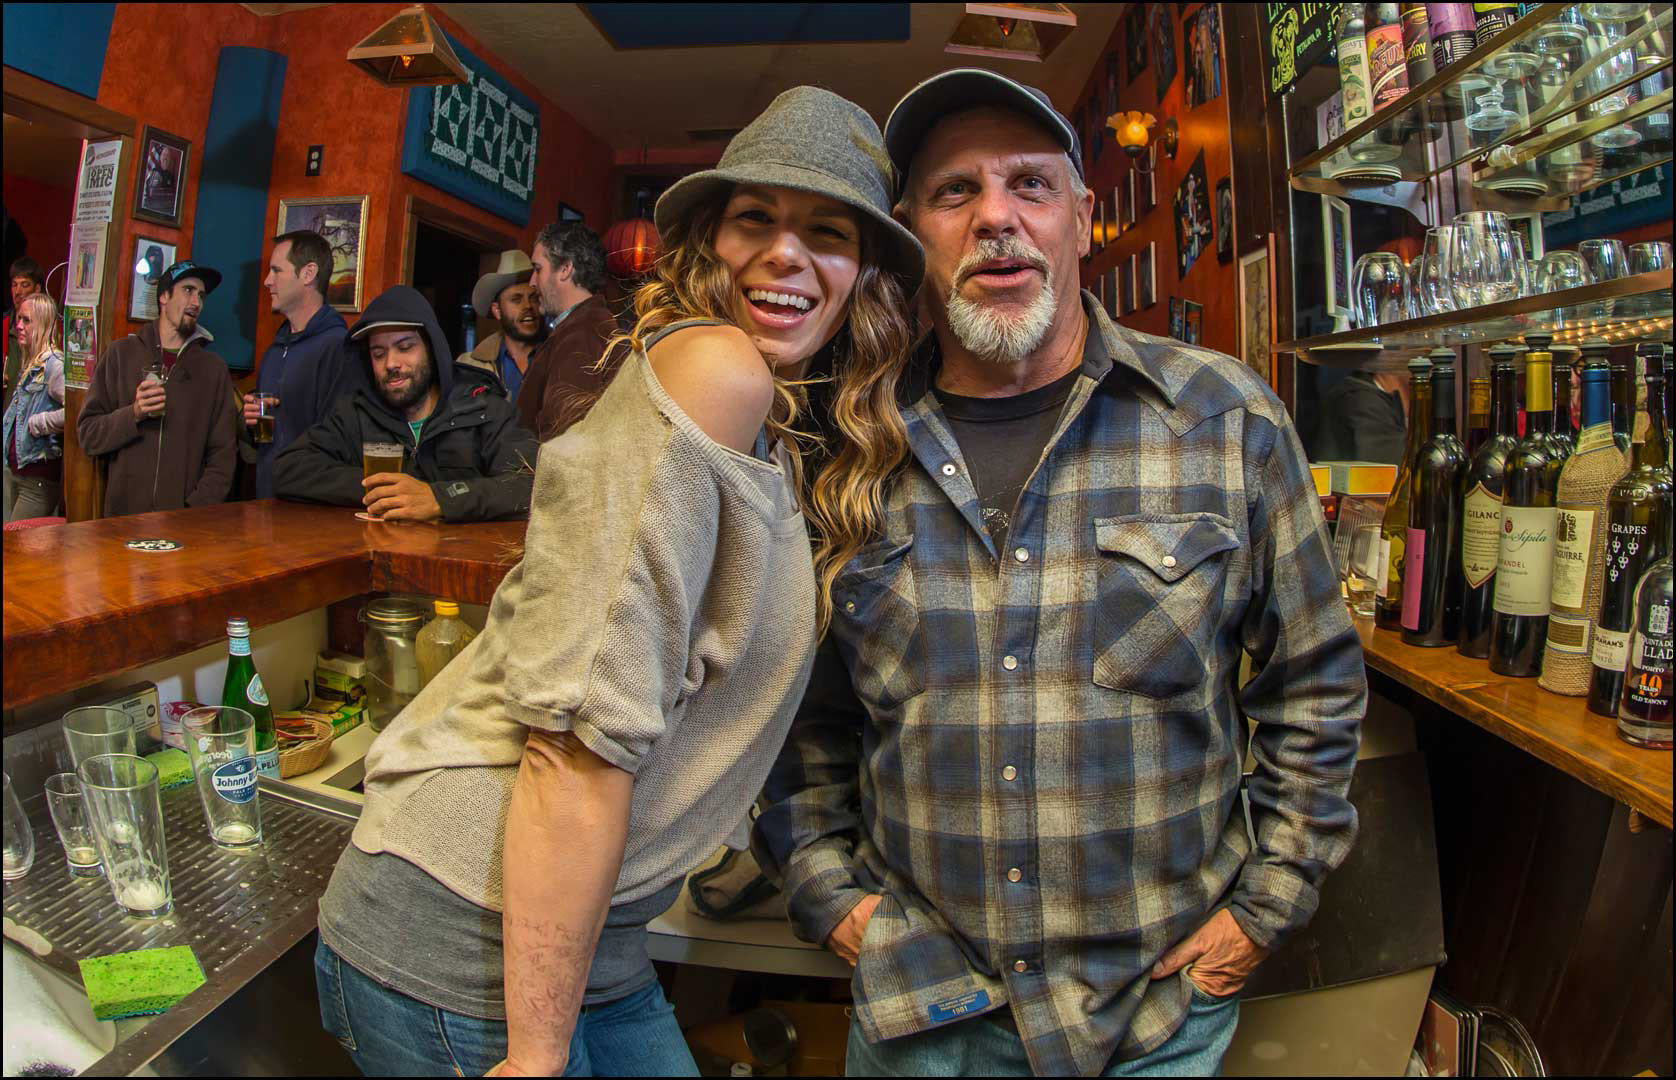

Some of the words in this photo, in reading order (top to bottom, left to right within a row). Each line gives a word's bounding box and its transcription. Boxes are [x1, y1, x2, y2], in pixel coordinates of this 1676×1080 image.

[91, 167, 115, 178] OPEN
[89, 176, 113, 189] MIC
[1611, 522, 1647, 535] GRAPES
[1642, 664, 1665, 673] PORTO
[1638, 672, 1663, 698] 10
[1631, 694, 1644, 703] OLD
[1644, 696, 1668, 706] TAWNY
[216, 776, 248, 788] Johnny
